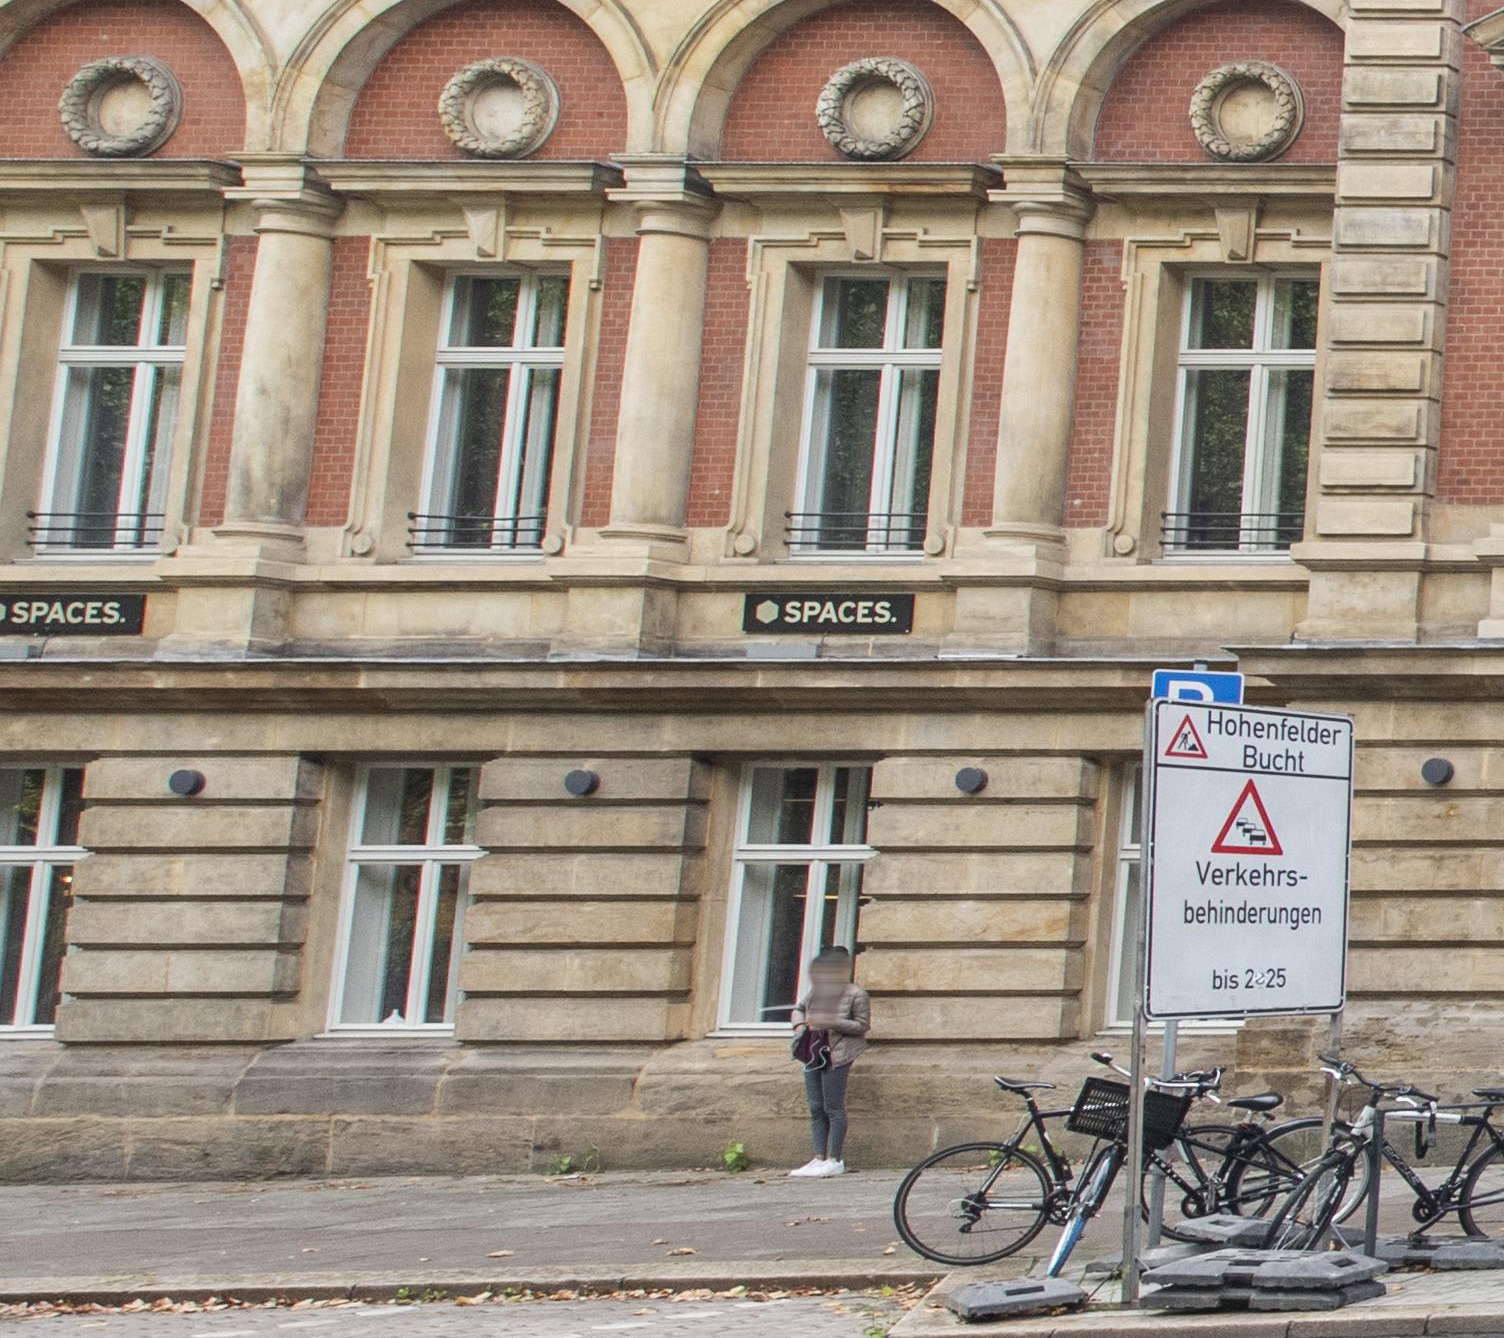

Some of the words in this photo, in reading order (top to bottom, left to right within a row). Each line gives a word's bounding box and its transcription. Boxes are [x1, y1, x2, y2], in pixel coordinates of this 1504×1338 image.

[11, 601, 126, 624] SPACES.
[784, 601, 897, 623] SPACES.
[1207, 710, 1342, 746] Hohenfelder
[1243, 745, 1305, 772] Bucht
[1196, 861, 1308, 887] Verkehrs-
[1184, 900, 1322, 930] behinderungen
[1212, 970, 1239, 990] bis
[1244, 968, 1287, 989] 225
